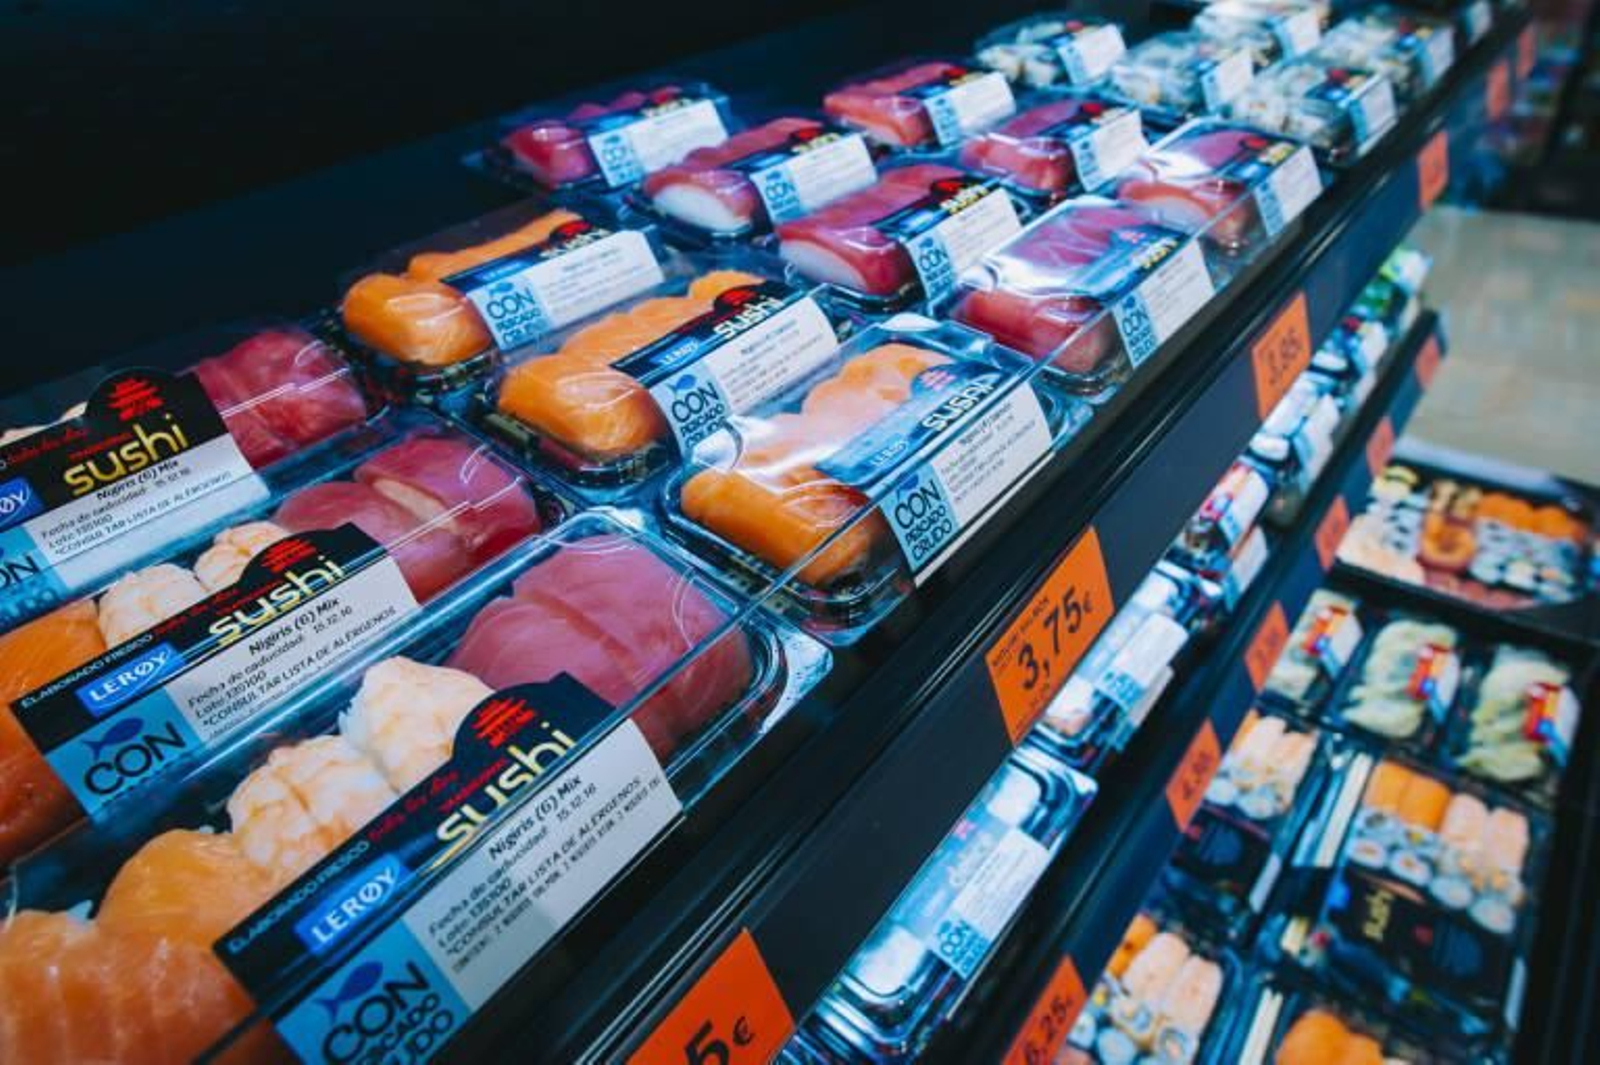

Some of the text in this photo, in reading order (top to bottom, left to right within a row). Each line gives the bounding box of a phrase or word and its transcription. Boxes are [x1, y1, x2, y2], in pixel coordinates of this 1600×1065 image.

[488, 288, 535, 320] CON
[672, 382, 721, 421] CON
[63, 413, 189, 497] sushi
[894, 480, 942, 531] CON
[911, 518, 954, 562] CRUDO
[209, 555, 346, 647] sushi
[248, 620, 294, 656] Nigiris
[316, 595, 342, 620] Mix
[88, 648, 171, 703] LERØY
[226, 668, 247, 688] de
[281, 655, 315, 688] LISTA
[314, 645, 335, 666] DE
[84, 721, 187, 797] CON
[436, 720, 580, 846] sushi
[469, 881, 489, 902] de
[556, 781, 598, 822] 15.12.16
[488, 815, 536, 862] Nigiris
[557, 774, 582, 801] Mix
[527, 848, 562, 889] LISTA
[560, 833, 579, 857] DE
[311, 866, 400, 946] LERØY
[322, 958, 430, 1064] CON
